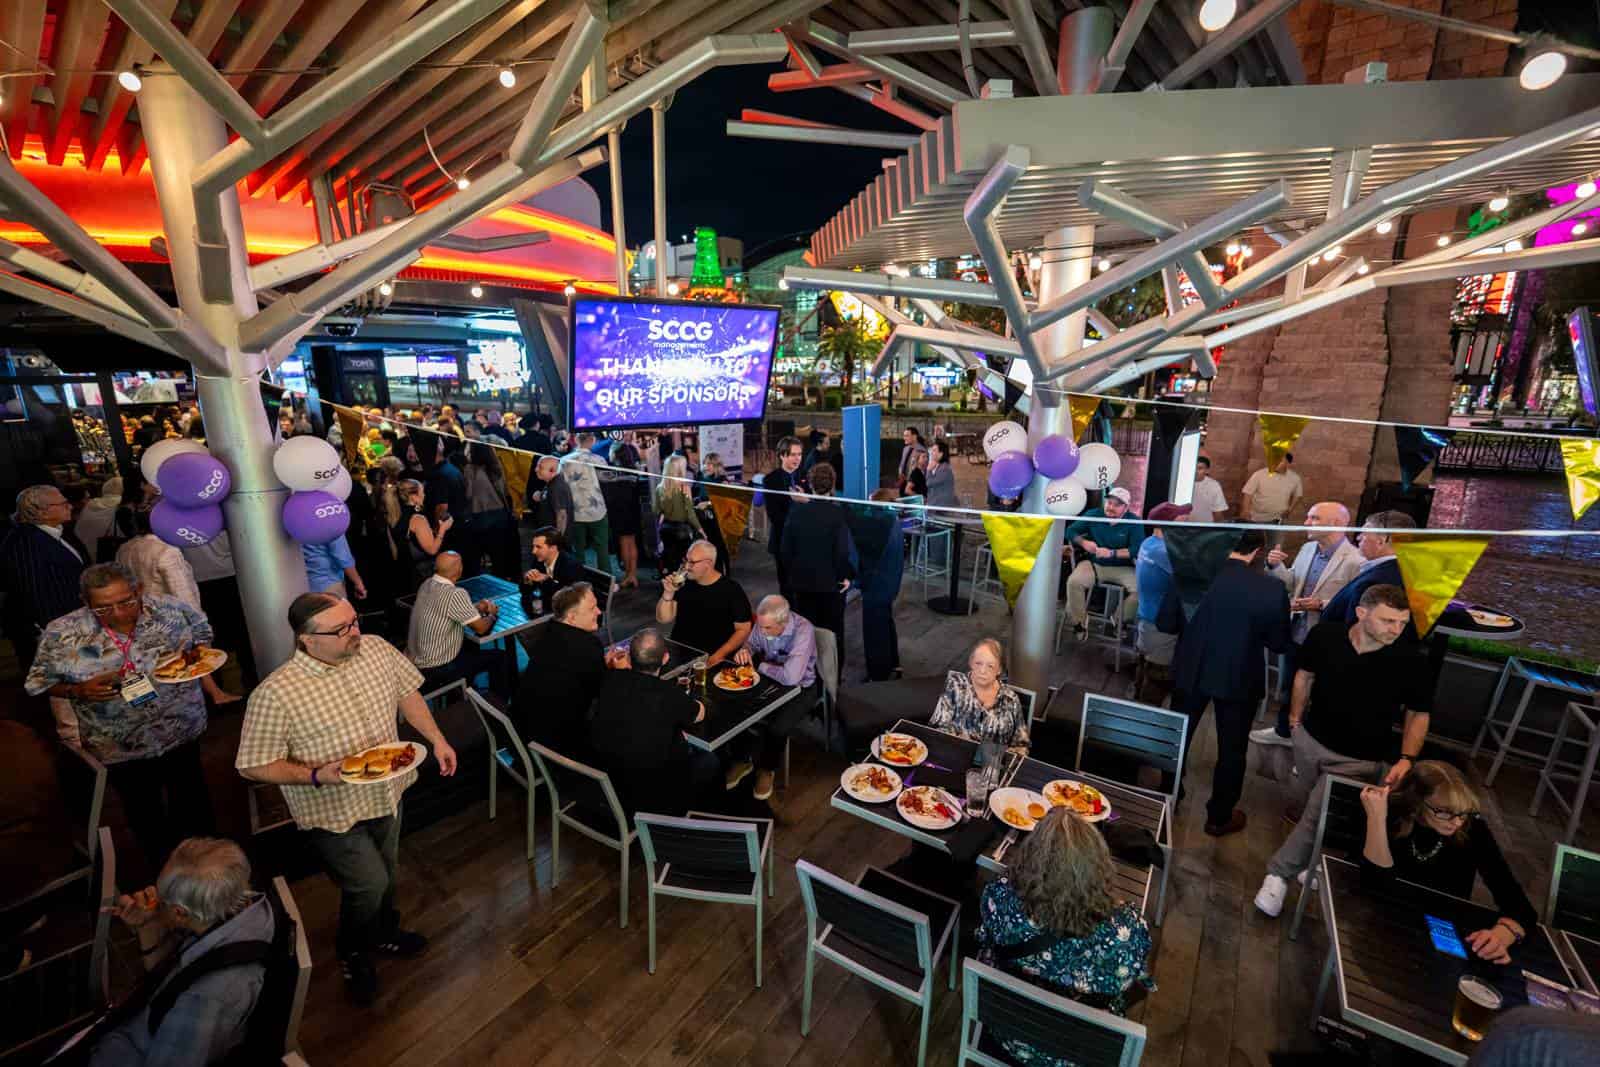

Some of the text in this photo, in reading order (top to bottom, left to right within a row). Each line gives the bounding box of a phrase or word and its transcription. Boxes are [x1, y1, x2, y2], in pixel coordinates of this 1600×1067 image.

[648, 319, 713, 341] SCCG
[600, 357, 670, 377] THAN
[596, 385, 750, 405] OUR SPONSORS
[198, 469, 223, 499] SCCG
